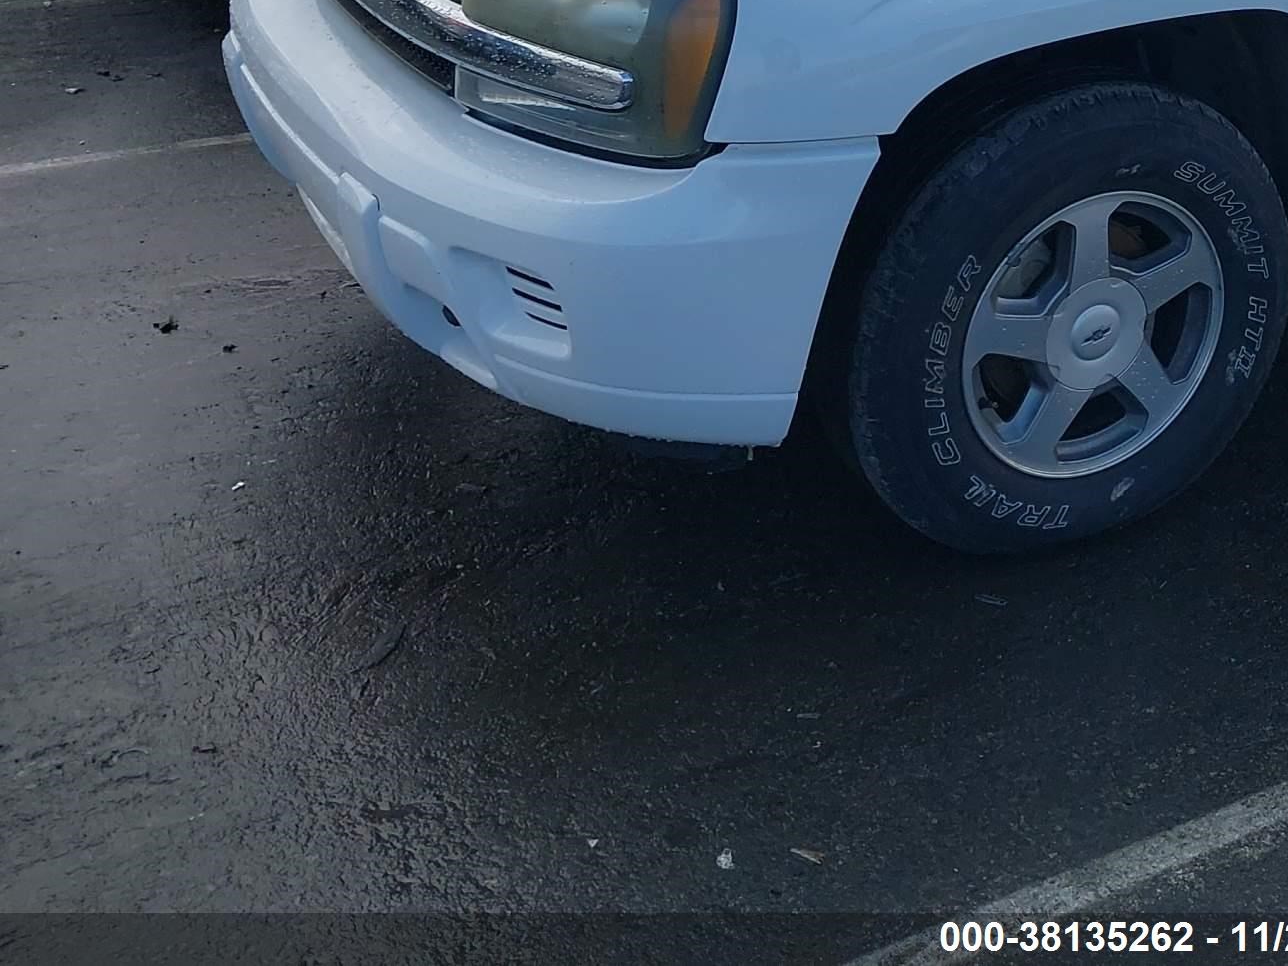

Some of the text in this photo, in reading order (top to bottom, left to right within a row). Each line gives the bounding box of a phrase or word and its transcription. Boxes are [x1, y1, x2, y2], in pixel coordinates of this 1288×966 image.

[1173, 160, 1270, 280] SUMMIT
[925, 254, 982, 466] CLIMBER
[963, 474, 1073, 530] TRAIL
